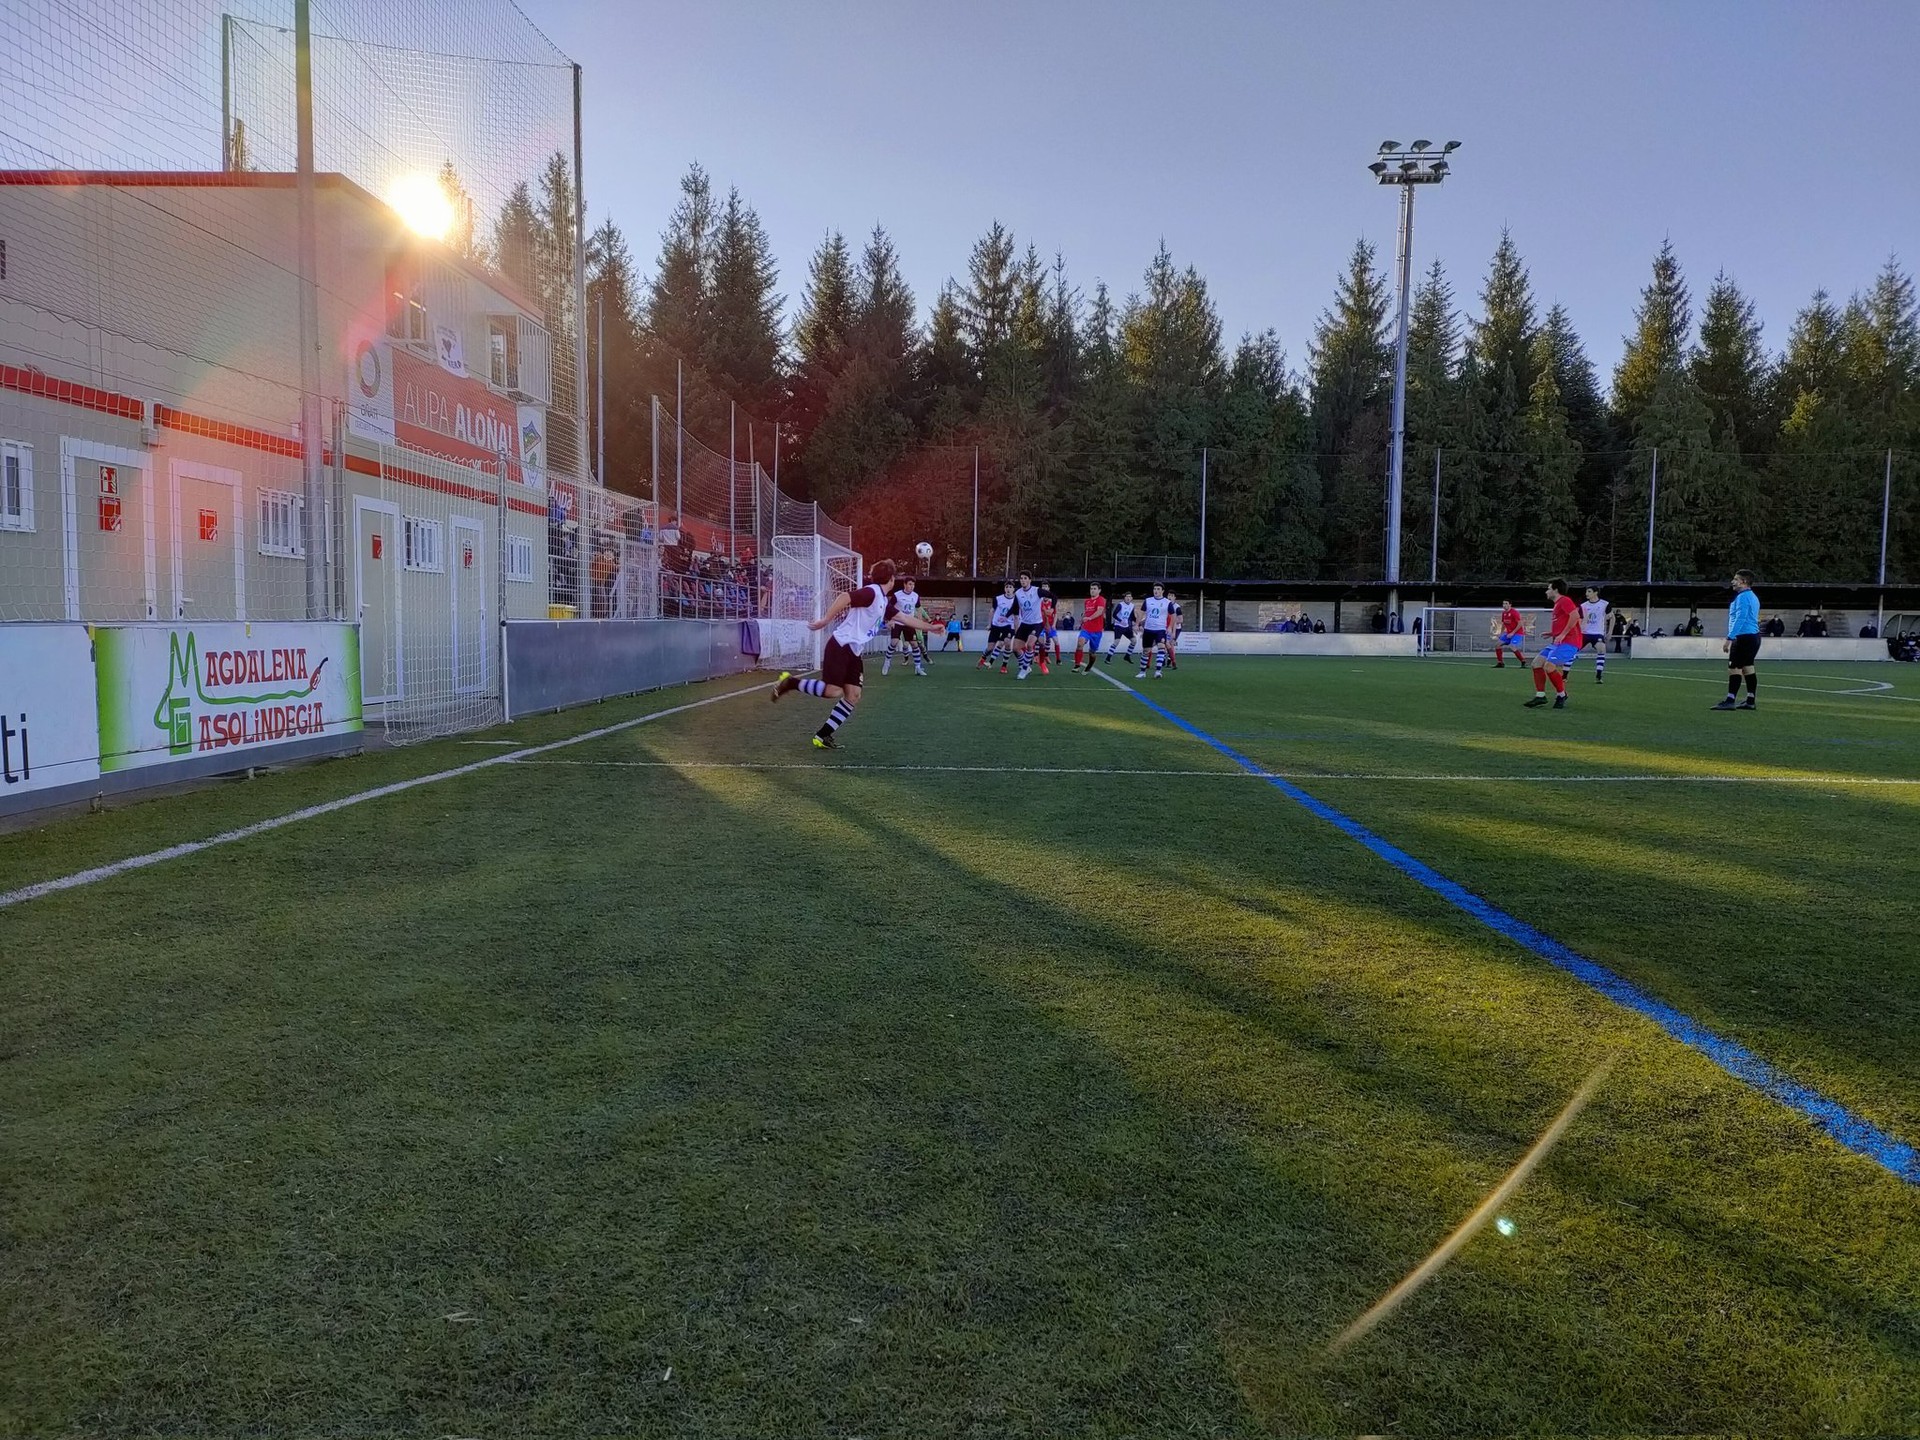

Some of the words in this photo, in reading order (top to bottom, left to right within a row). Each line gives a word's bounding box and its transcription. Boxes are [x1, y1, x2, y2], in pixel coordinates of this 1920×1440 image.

[404, 382, 450, 434] AUPA
[454, 403, 513, 458] ALOÑA!
[170, 631, 309, 688] MAGDALENA
